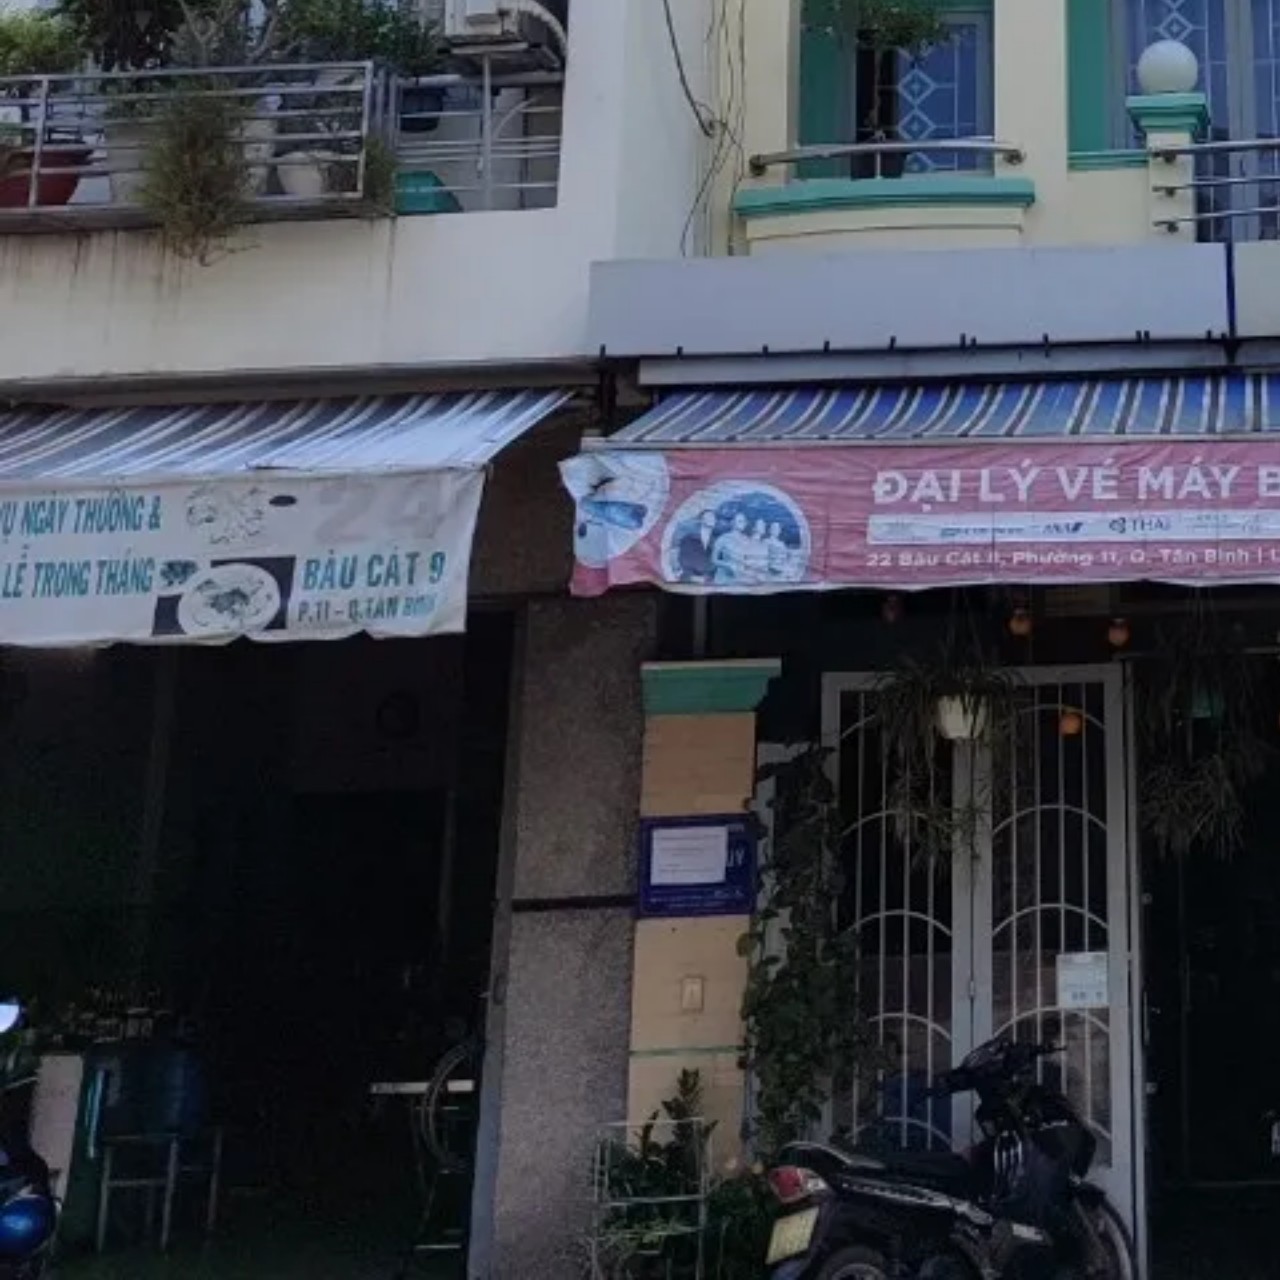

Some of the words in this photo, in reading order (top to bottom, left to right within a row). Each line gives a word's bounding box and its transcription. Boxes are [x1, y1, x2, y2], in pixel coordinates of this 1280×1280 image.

[871, 468, 961, 512] ĐẠI
[979, 458, 1042, 502] LÝ
[1055, 458, 1121, 500] VÉ
[1137, 455, 1240, 500] MÁY
[148, 495, 162, 531] &
[31, 558, 91, 598] TRONG
[95, 546, 156, 596] THÁNG
[366, 545, 421, 588] CÁT
[428, 551, 447, 584] 9
[866, 552, 892, 566] 22
